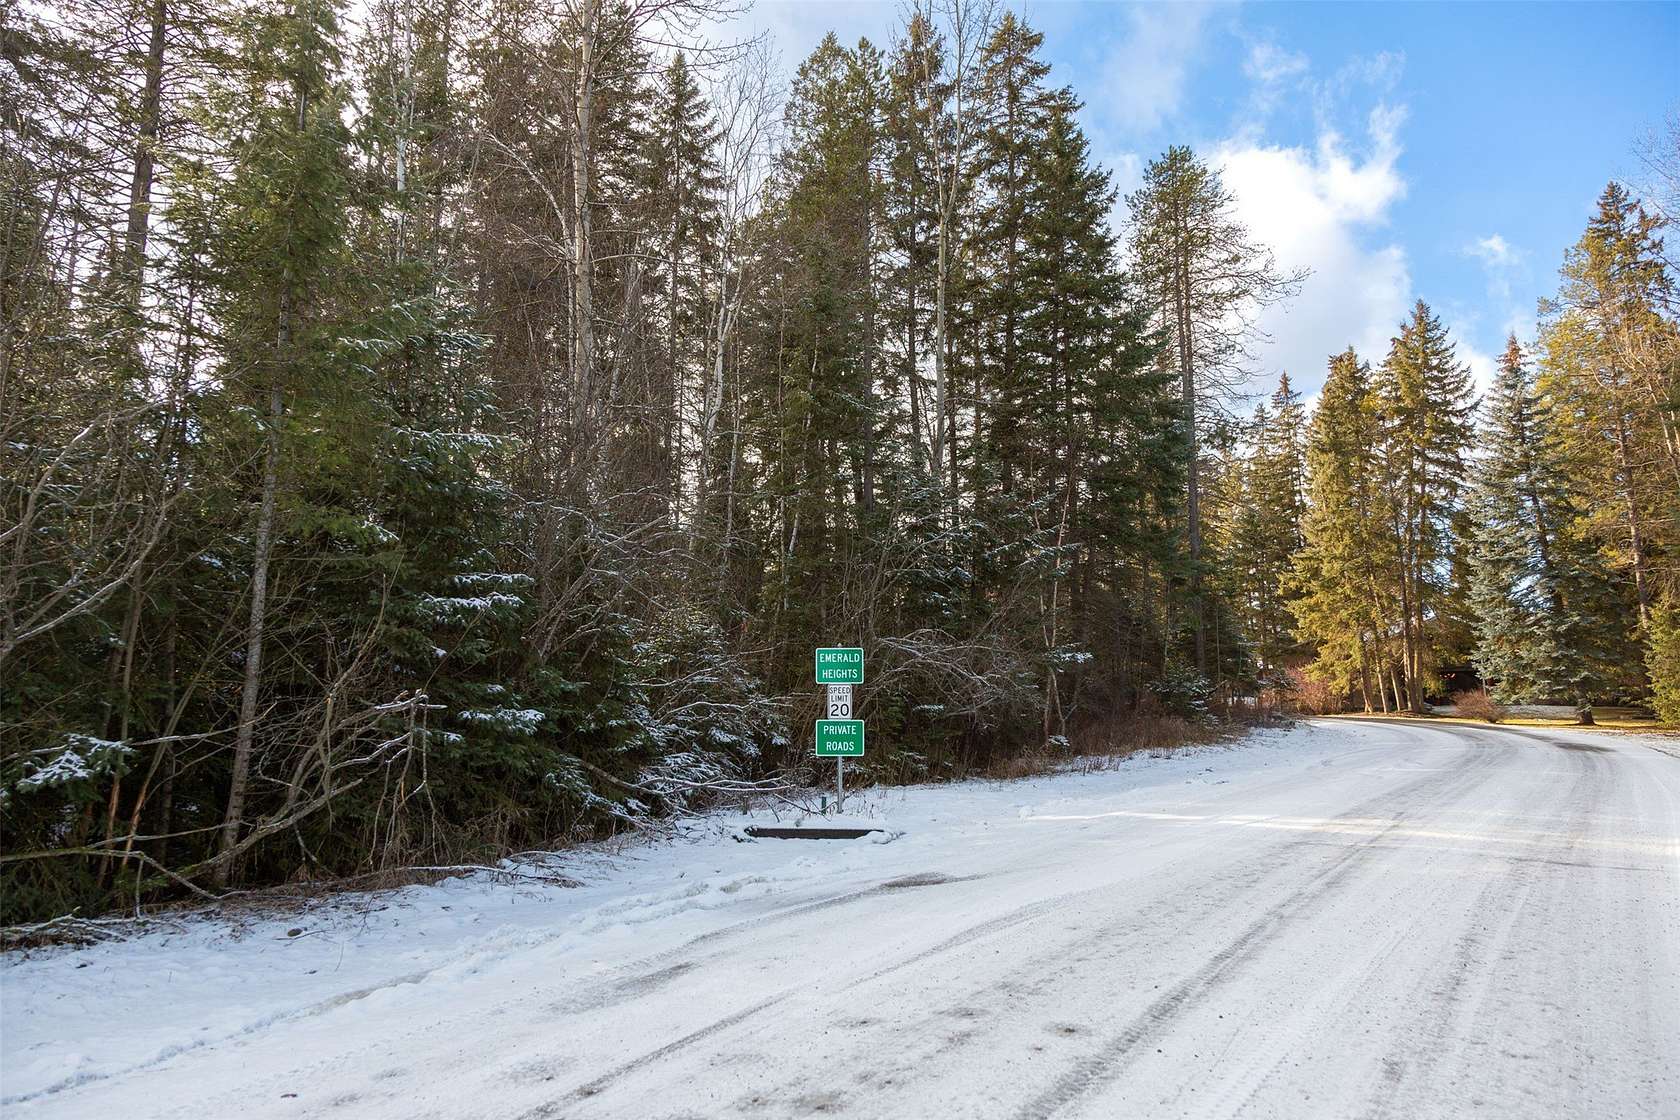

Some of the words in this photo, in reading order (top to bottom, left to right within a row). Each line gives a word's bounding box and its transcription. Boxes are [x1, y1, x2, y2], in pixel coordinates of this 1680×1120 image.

[819, 653, 860, 663] EMERALD
[822, 669, 858, 679] HEIGHTS
[830, 703, 850, 717] 20
[823, 725, 857, 735] PRIVATE
[826, 741, 855, 751] ROADS
